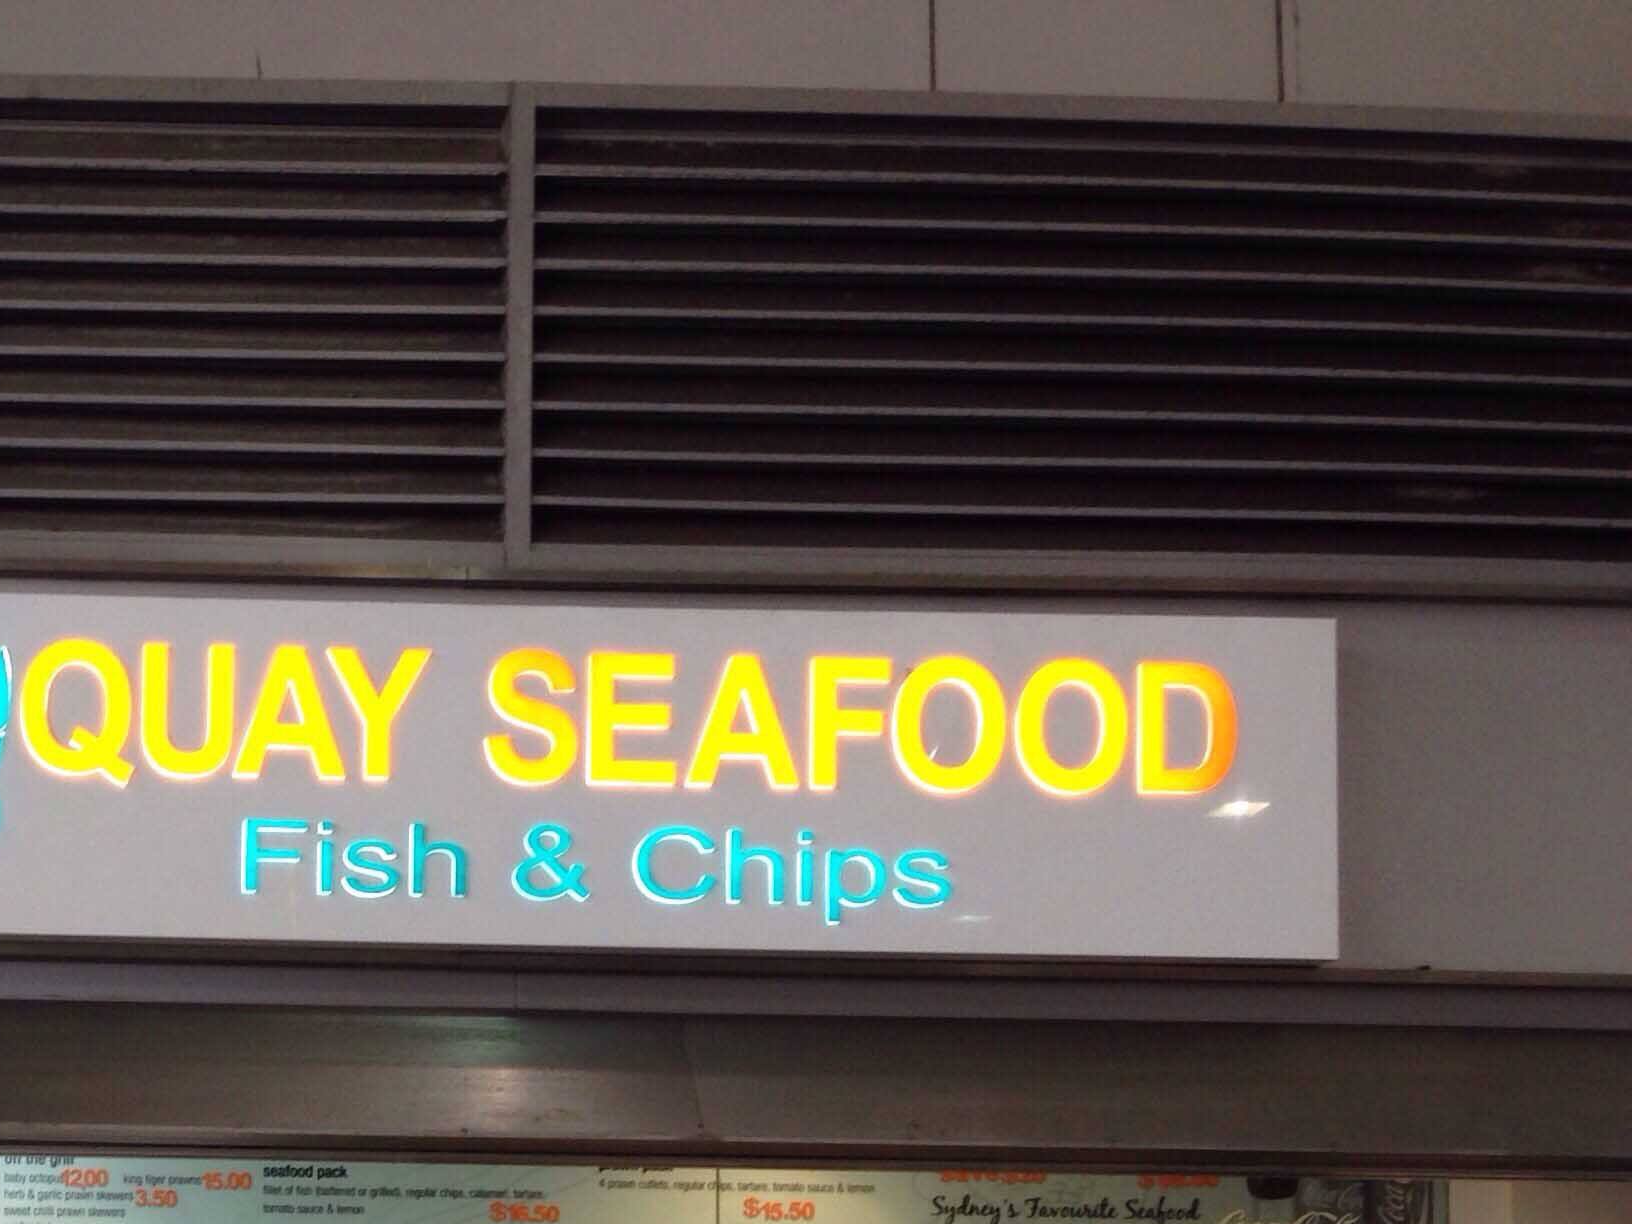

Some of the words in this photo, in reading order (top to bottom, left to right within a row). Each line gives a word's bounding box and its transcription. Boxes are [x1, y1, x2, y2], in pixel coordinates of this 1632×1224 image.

[20, 638, 433, 788] QUAY
[483, 648, 1237, 795] SEAFOOD
[240, 817, 466, 898] Fish
[511, 824, 590, 902] &
[631, 825, 951, 926] Chips
[29, 1174, 62, 1184] octopu
[263, 1164, 313, 1178] seafood
[317, 1166, 348, 1180] pack
[1024, 1197, 1118, 1220] Favourite
